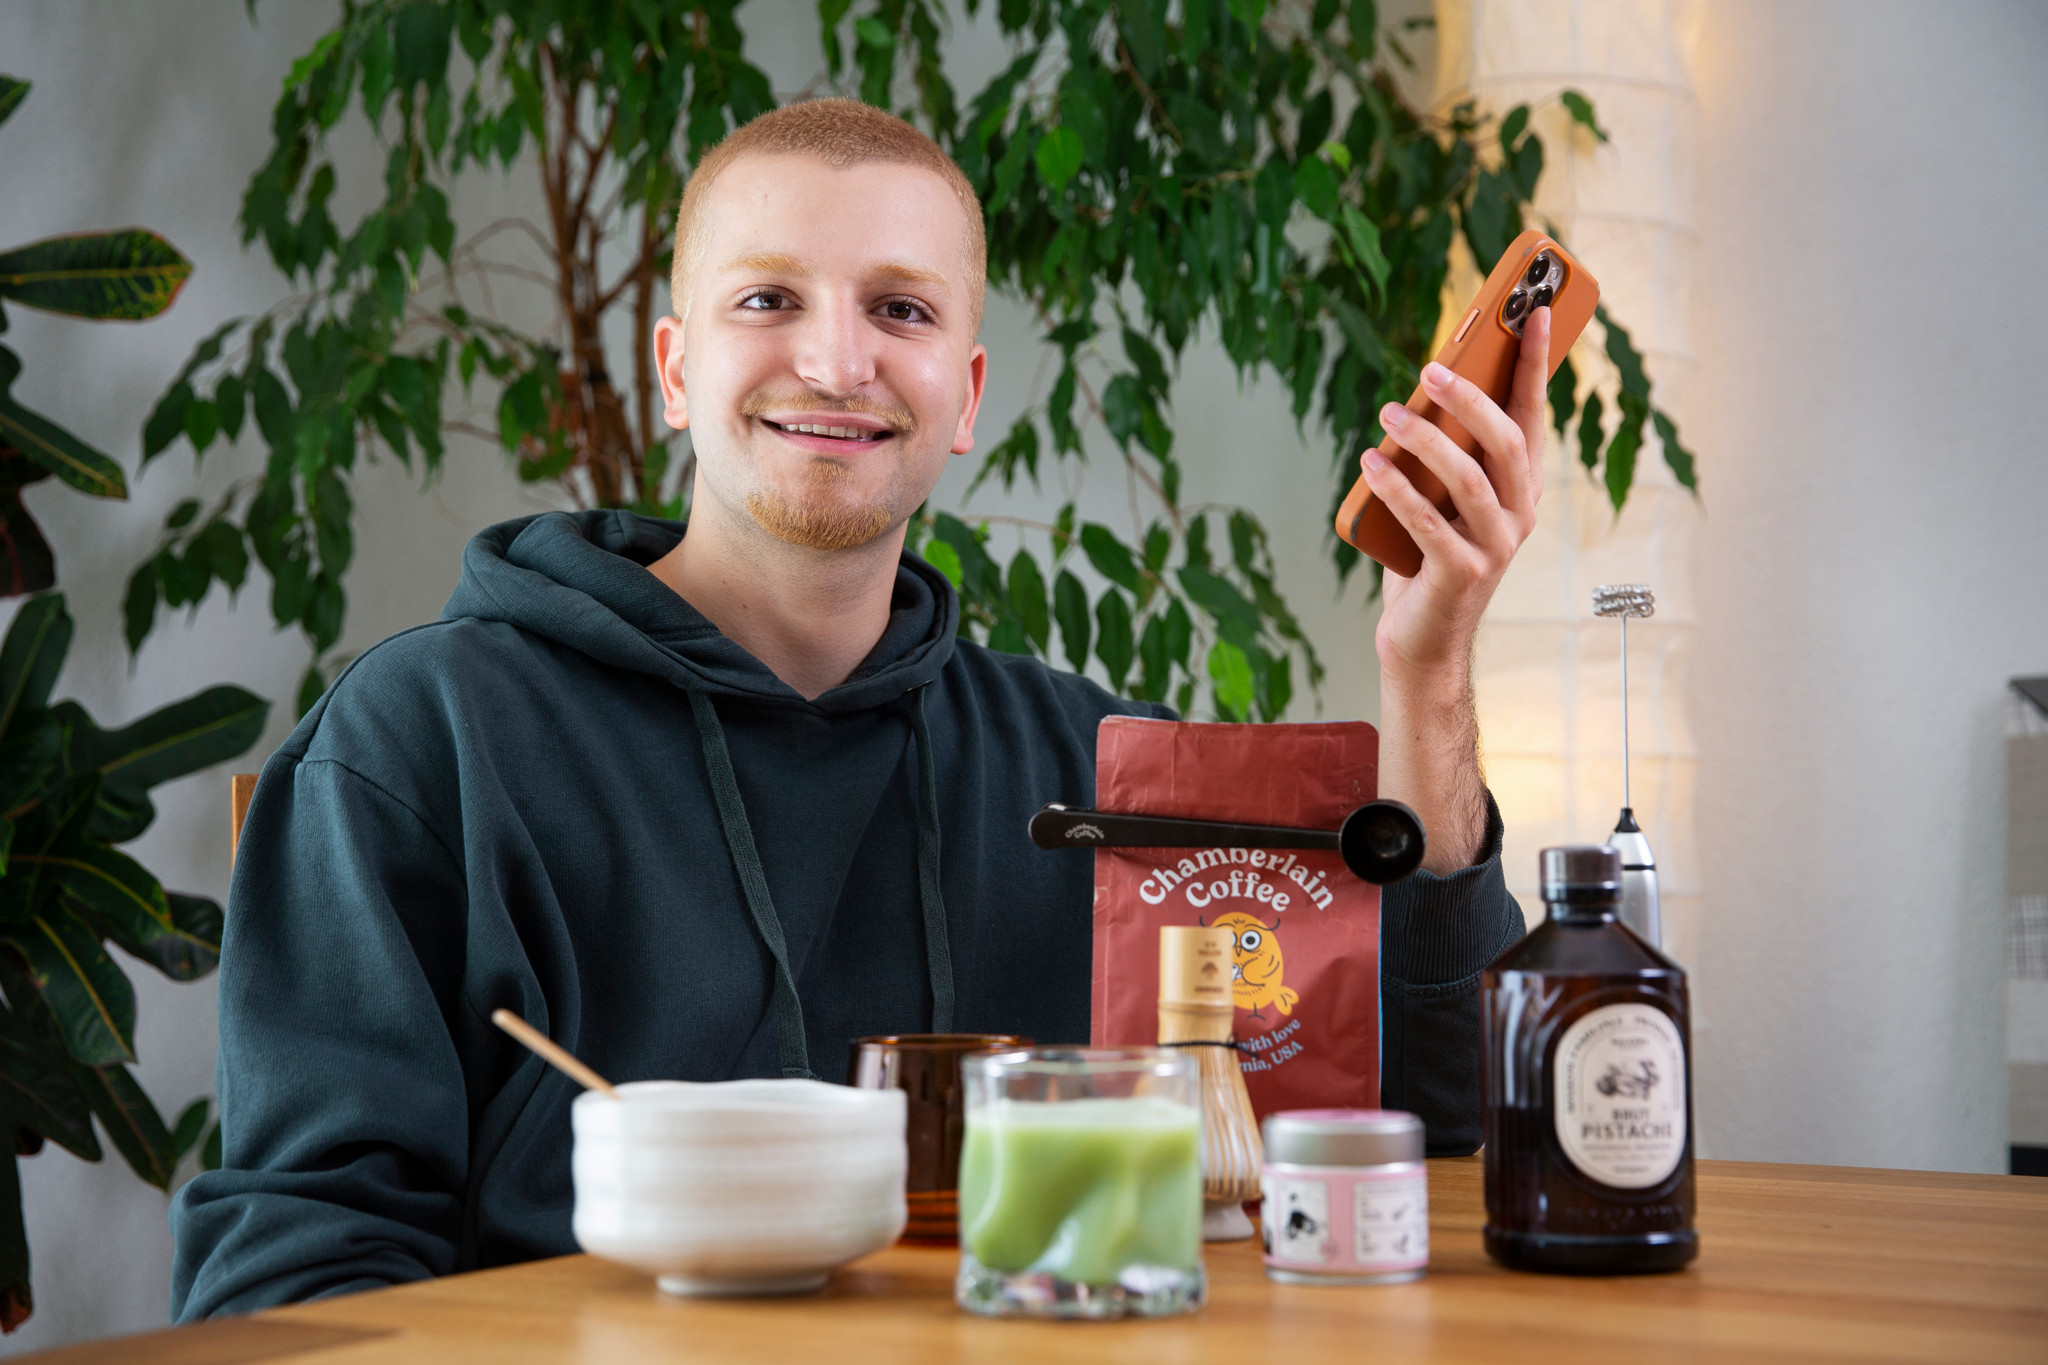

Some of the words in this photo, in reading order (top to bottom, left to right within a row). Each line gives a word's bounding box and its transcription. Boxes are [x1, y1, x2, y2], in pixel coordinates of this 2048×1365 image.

[1139, 847, 1334, 911] Chamberlain
[1185, 869, 1291, 912] Coffee
[1271, 1019, 1301, 1043] love
[1270, 1040, 1304, 1065] USA
